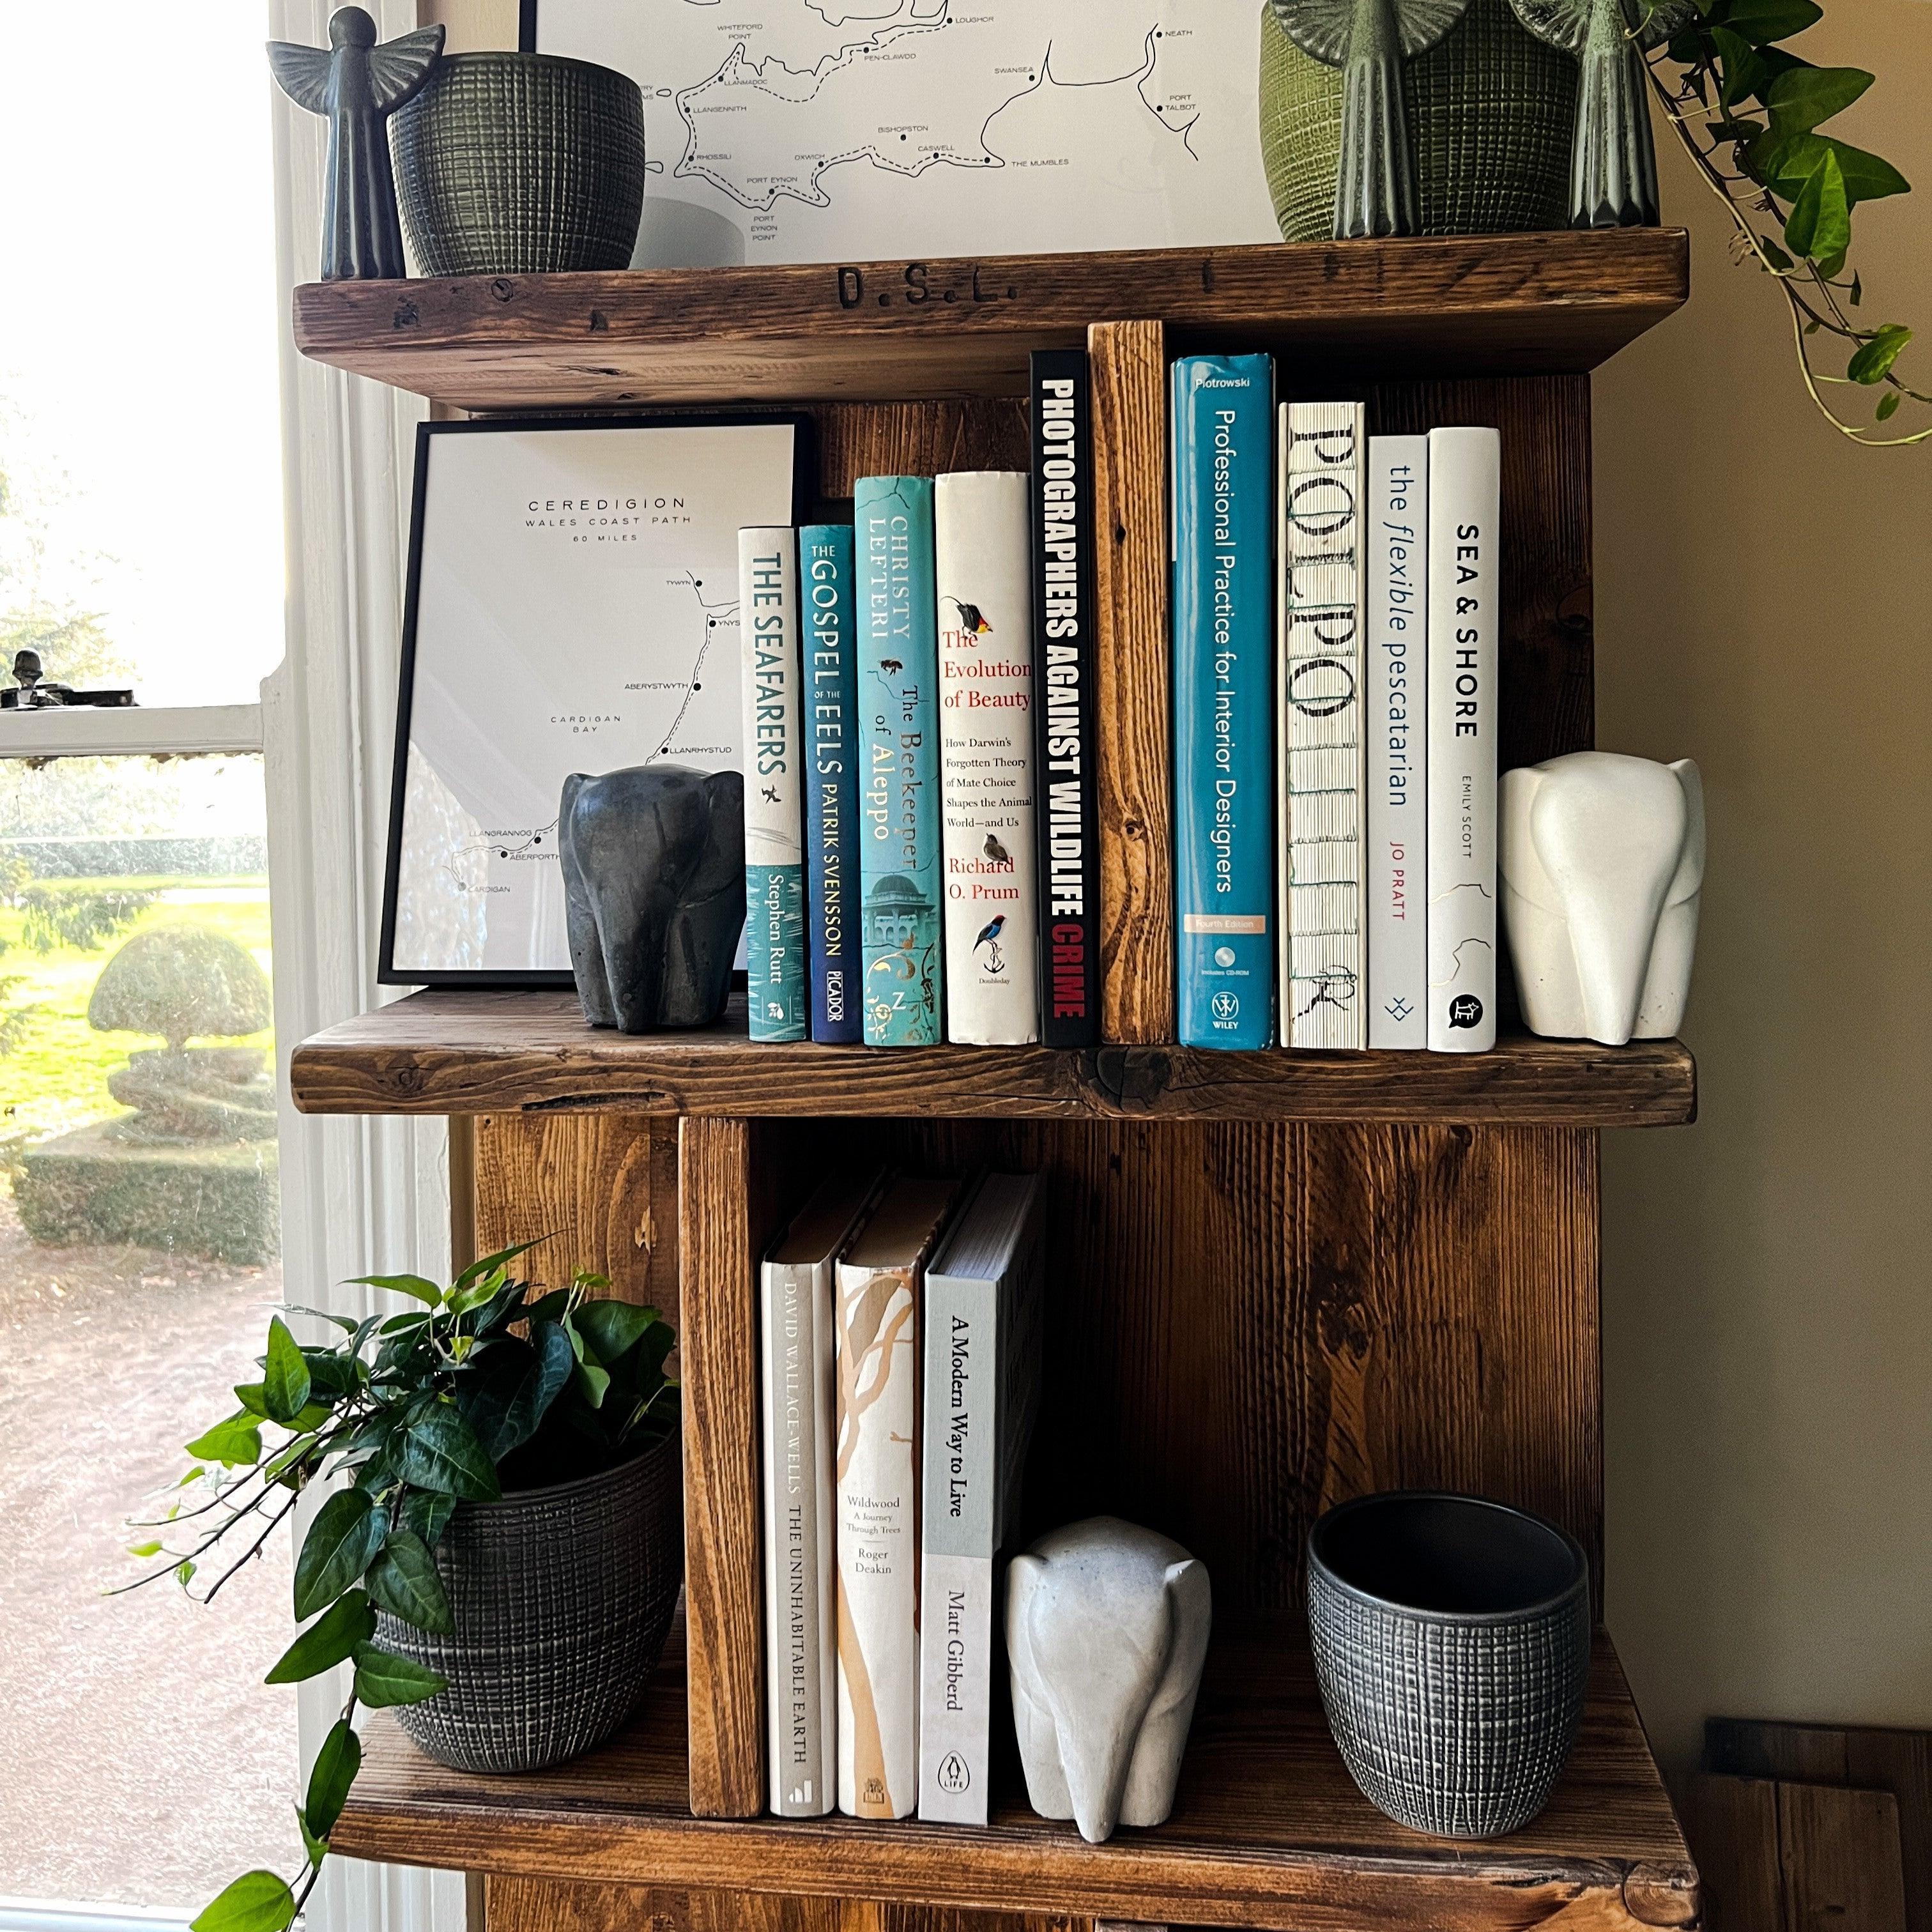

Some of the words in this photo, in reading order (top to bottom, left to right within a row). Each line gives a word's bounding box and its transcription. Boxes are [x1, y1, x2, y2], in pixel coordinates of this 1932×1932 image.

[693, 105, 747, 114] LLANGENNITH
[878, 125, 928, 134] BISHOPSTON
[1030, 158, 1069, 167] MUMBLES
[1195, 378, 1250, 388] Piotrowski
[1215, 410, 1235, 547] Professional
[1390, 464, 1414, 511] the
[525, 518, 578, 527] WALES
[589, 518, 640, 526] COAST
[528, 498, 686, 511] CEREDIGION
[1042, 379, 1078, 638] PHOTOGRAPHERS
[811, 546, 835, 557] THE
[1288, 424, 1356, 717] POLPO
[1456, 524, 1479, 585] SEA
[753, 553, 782, 607] THE
[870, 518, 889, 638] LEFTERI
[891, 516, 910, 639] CHRISTY
[1383, 521, 1414, 631] flexible
[1215, 556, 1235, 644] Practice
[1456, 597, 1478, 616] &
[811, 560, 839, 685] GOSPEL
[943, 631, 978, 648] The
[945, 660, 1032, 678] Evolution
[1215, 651, 1237, 686] for
[1455, 628, 1478, 737] SHORE
[755, 615, 786, 776] SEAFARERS
[903, 685, 917, 722] The
[944, 691, 963, 707] of
[969, 691, 1031, 711] Beauty
[1046, 645, 1080, 774] AGAINST
[816, 705, 843, 774] EELS
[875, 715, 891, 735] of
[946, 739, 966, 747] How
[969, 737, 1011, 747] Darwin's
[1215, 691, 1236, 772] Interior
[1382, 643, 1414, 806] pescatarian
[947, 758, 990, 770] Forgotten
[993, 757, 1027, 769] Theory
[947, 778, 956, 787] of
[957, 779, 981, 787] Mate
[983, 778, 1016, 786] Choice
[866, 744, 895, 839] Aleppo
[894, 731, 923, 869] Beekeeper
[947, 798, 978, 809] Shapes
[981, 797, 997, 807] the
[999, 796, 1032, 807] Animal
[1462, 776, 1471, 811] EMILY
[822, 784, 839, 848] PATRIK
[1006, 818, 1019, 827] Us
[1211, 779, 1236, 893] Designers
[1049, 781, 1083, 916] WILDLIFE
[1390, 841, 1404, 860] JO
[1462, 816, 1471, 859] SCOTT
[949, 857, 1015, 873] Richard
[765, 874, 785, 941] Stephen
[824, 855, 841, 956] SVENSSON
[949, 884, 966, 899] O.
[972, 885, 1019, 900] Prum
[1392, 870, 1405, 921] PRATT
[770, 947, 785, 984] Rutt
[1052, 924, 1084, 1018] CRIME
[827, 970, 843, 1022] PICADOR
[785, 1282, 798, 1338] DAVID
[953, 1315, 969, 1333] A
[951, 1337, 969, 1407] Modern
[786, 1345, 802, 1494] WALLACE-WELLS
[946, 1413, 969, 1453] Way
[951, 1456, 963, 1475] to
[847, 1496, 900, 1508] Wildwood
[862, 1513, 893, 1523] Journey
[950, 1478, 968, 1518] Live
[789, 1505, 802, 1541] THE
[847, 1524, 878, 1534] Through
[881, 1524, 901, 1533] Trees
[855, 1563, 891, 1574] Deakin
[859, 1548, 888, 1560] Roger
[790, 1547, 805, 1696] UNINHABITABLE
[948, 1591, 965, 1634] Matt
[947, 1640, 964, 1711] Gibberd
[793, 1702, 806, 1764] EARTH
[944, 1780, 963, 1788] LIFE
